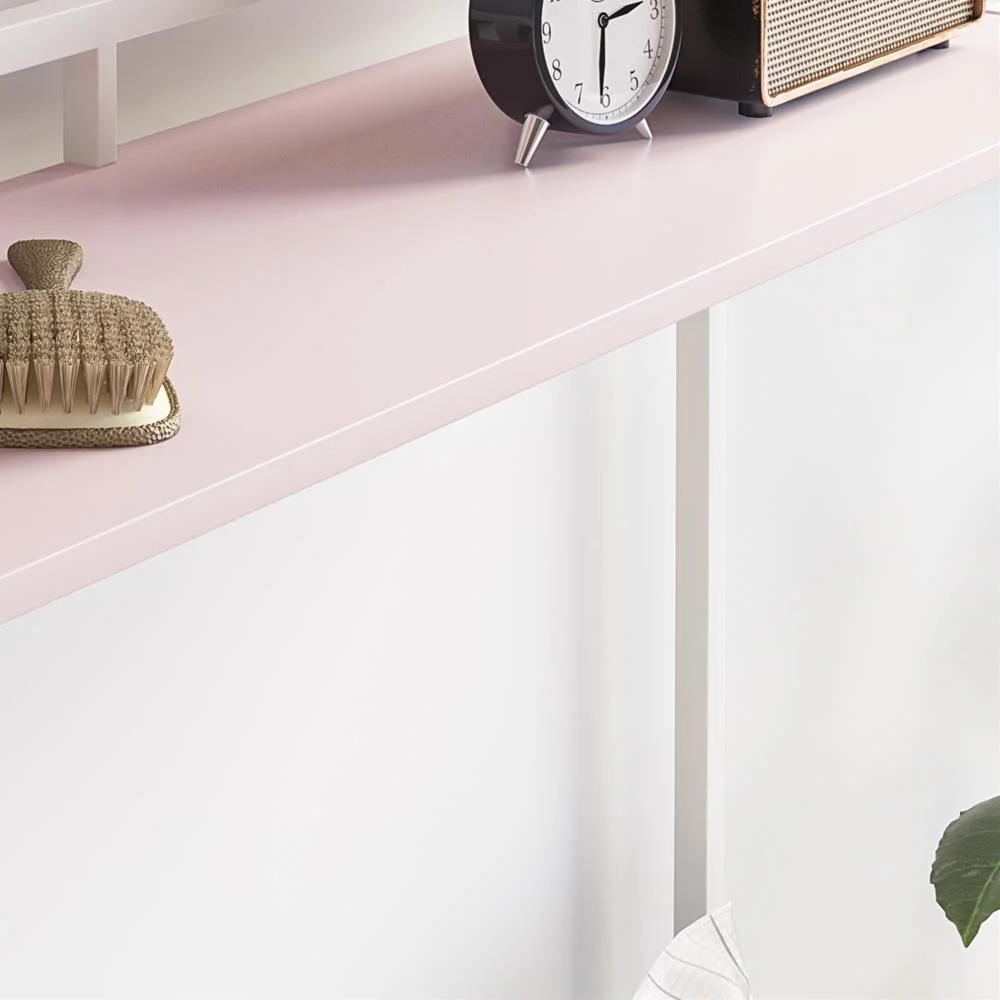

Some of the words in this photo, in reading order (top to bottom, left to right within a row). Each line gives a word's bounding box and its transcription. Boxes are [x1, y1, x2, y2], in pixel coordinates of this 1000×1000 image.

[542, 21, 552, 44] 9
[643, 38, 654, 59] 4
[551, 58, 562, 81] 8
[629, 69, 639, 91] 5
[574, 82, 584, 105] 7
[600, 85, 611, 108] 6
